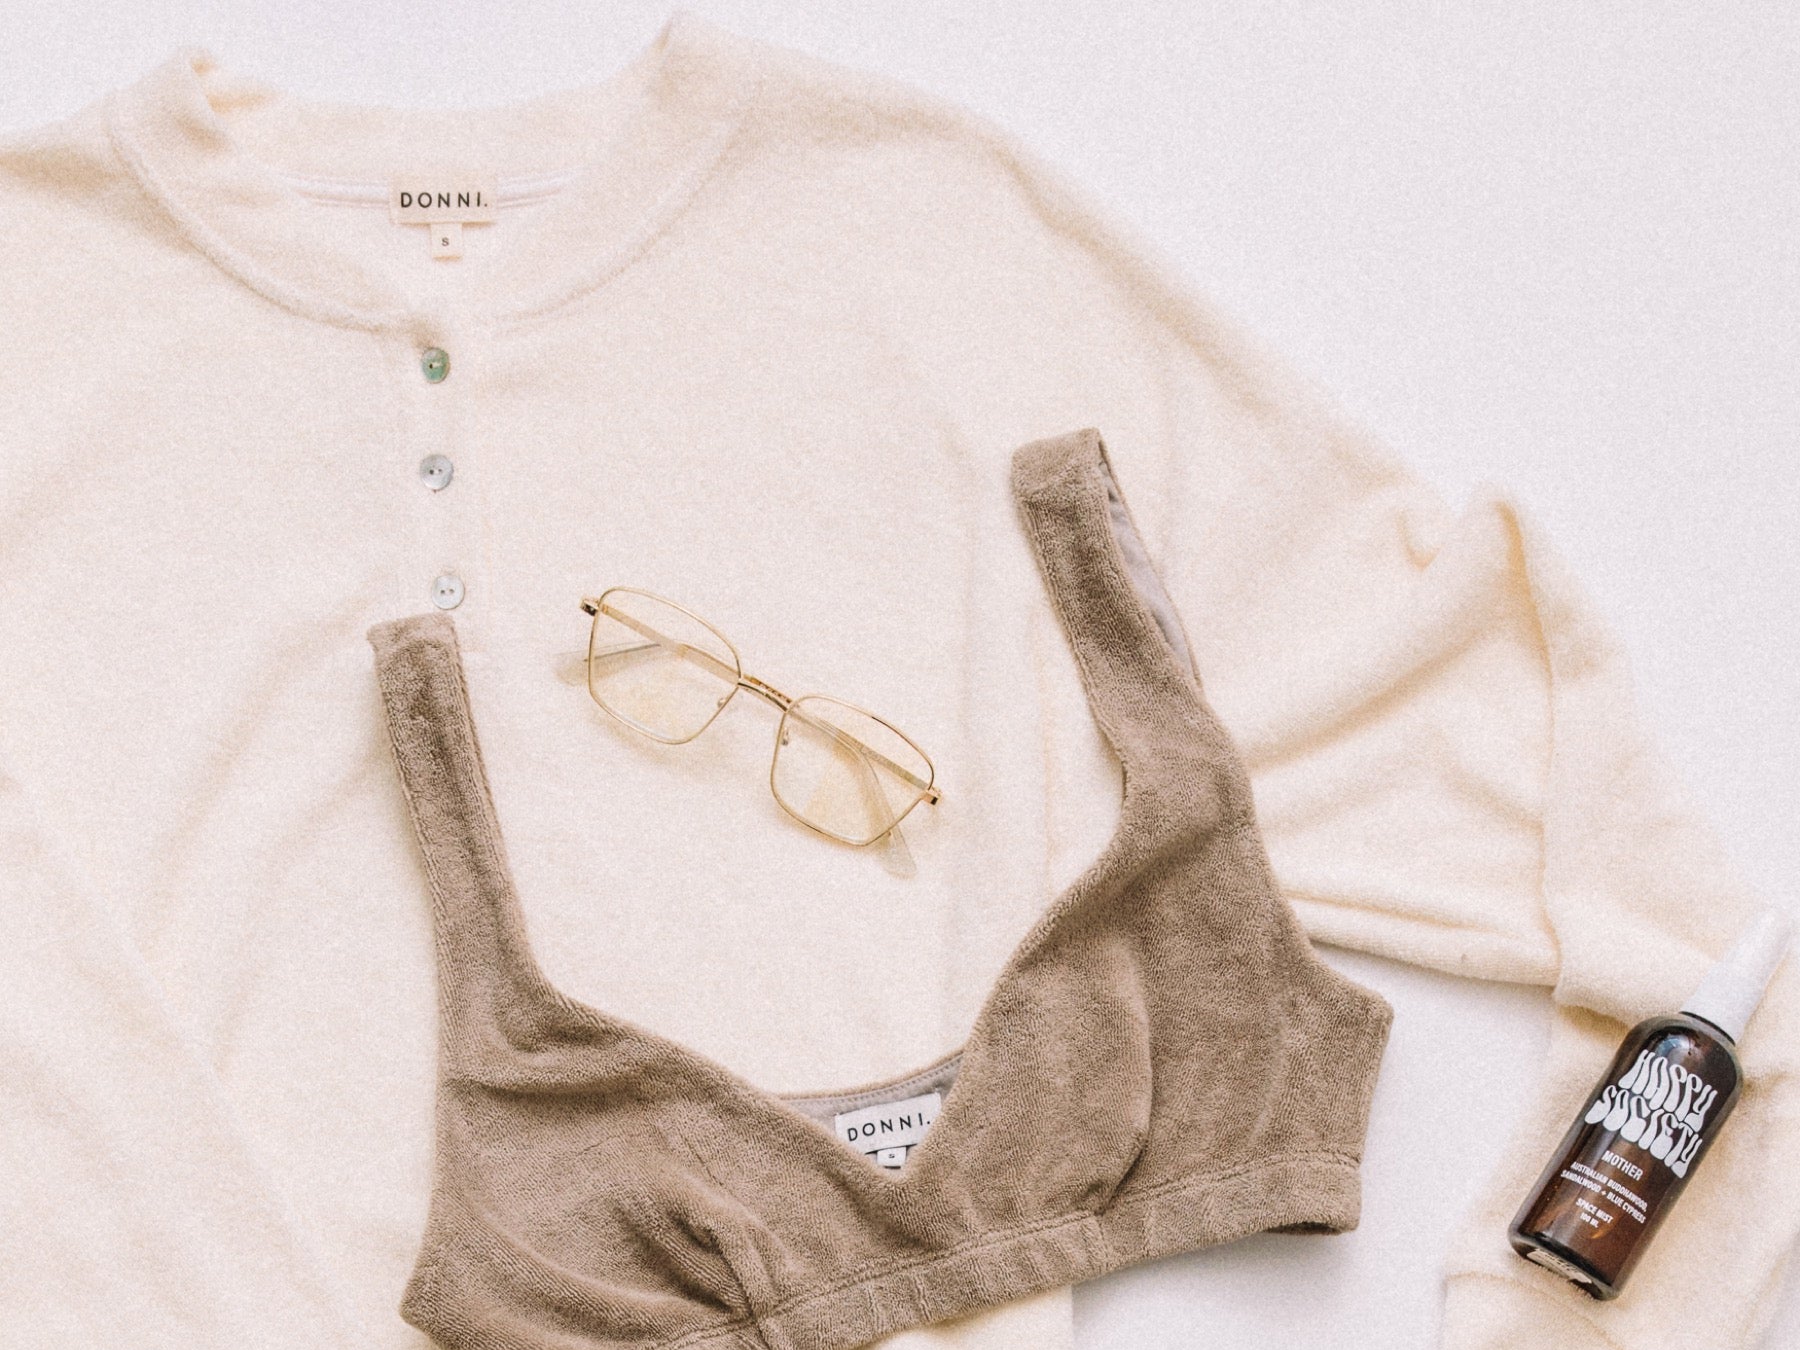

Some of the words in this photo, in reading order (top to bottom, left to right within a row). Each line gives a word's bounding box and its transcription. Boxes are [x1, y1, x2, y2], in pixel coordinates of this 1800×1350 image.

[400, 191, 488, 209] DONNI.
[1617, 1049, 1718, 1133] HAPPY
[846, 1112, 931, 1142] DONNI.
[1584, 1084, 1703, 1179] SOCIETY
[1570, 1161, 1609, 1184] AUSTRALIAN
[1601, 1150, 1644, 1181] MOTHER
[1560, 1169, 1602, 1193] SANDALWOOD
[1606, 1191, 1625, 1207] BLUE
[1622, 1202, 1646, 1224] CYPRESS
[1576, 1197, 1598, 1215] SPACE
[1595, 1209, 1614, 1224] MIST
